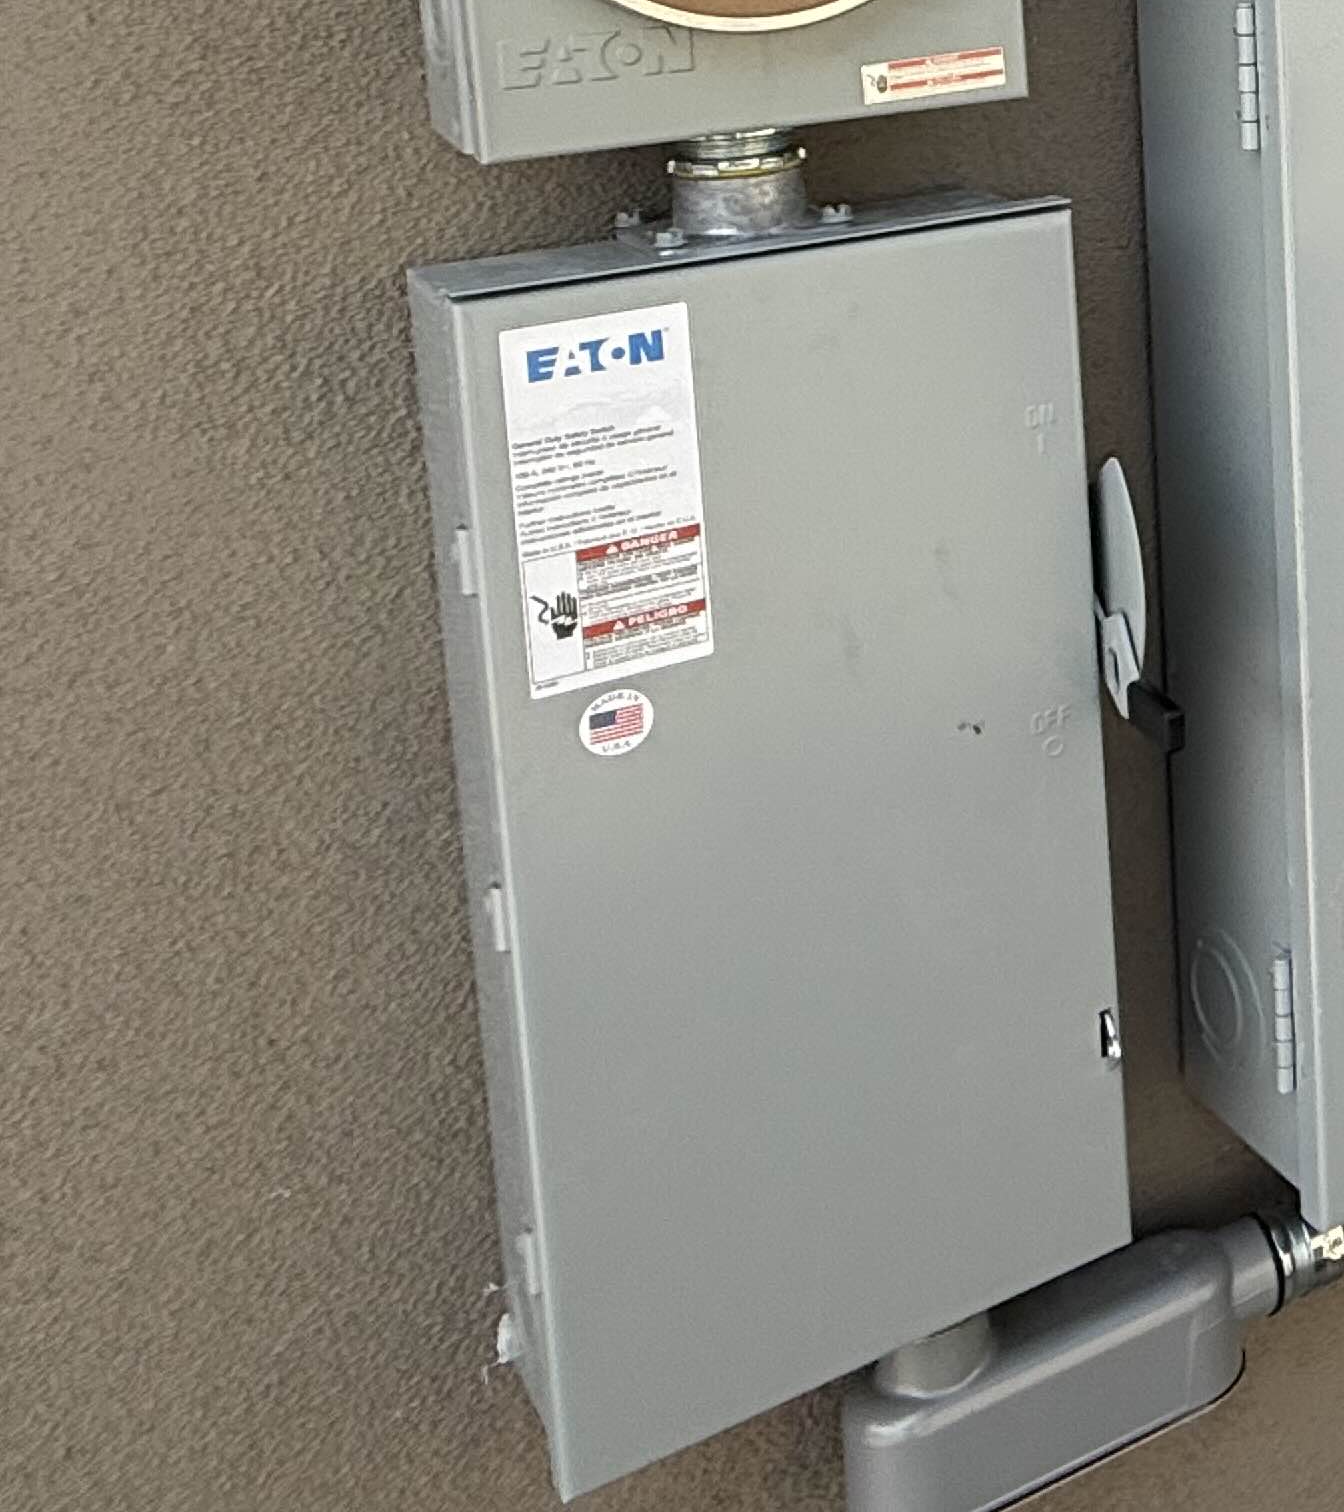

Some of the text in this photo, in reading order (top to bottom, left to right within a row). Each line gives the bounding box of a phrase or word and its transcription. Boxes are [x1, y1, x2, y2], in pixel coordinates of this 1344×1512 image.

[497, 25, 695, 90] EATON
[526, 329, 664, 383] EATON
[628, 605, 688, 626] PELIGRO
